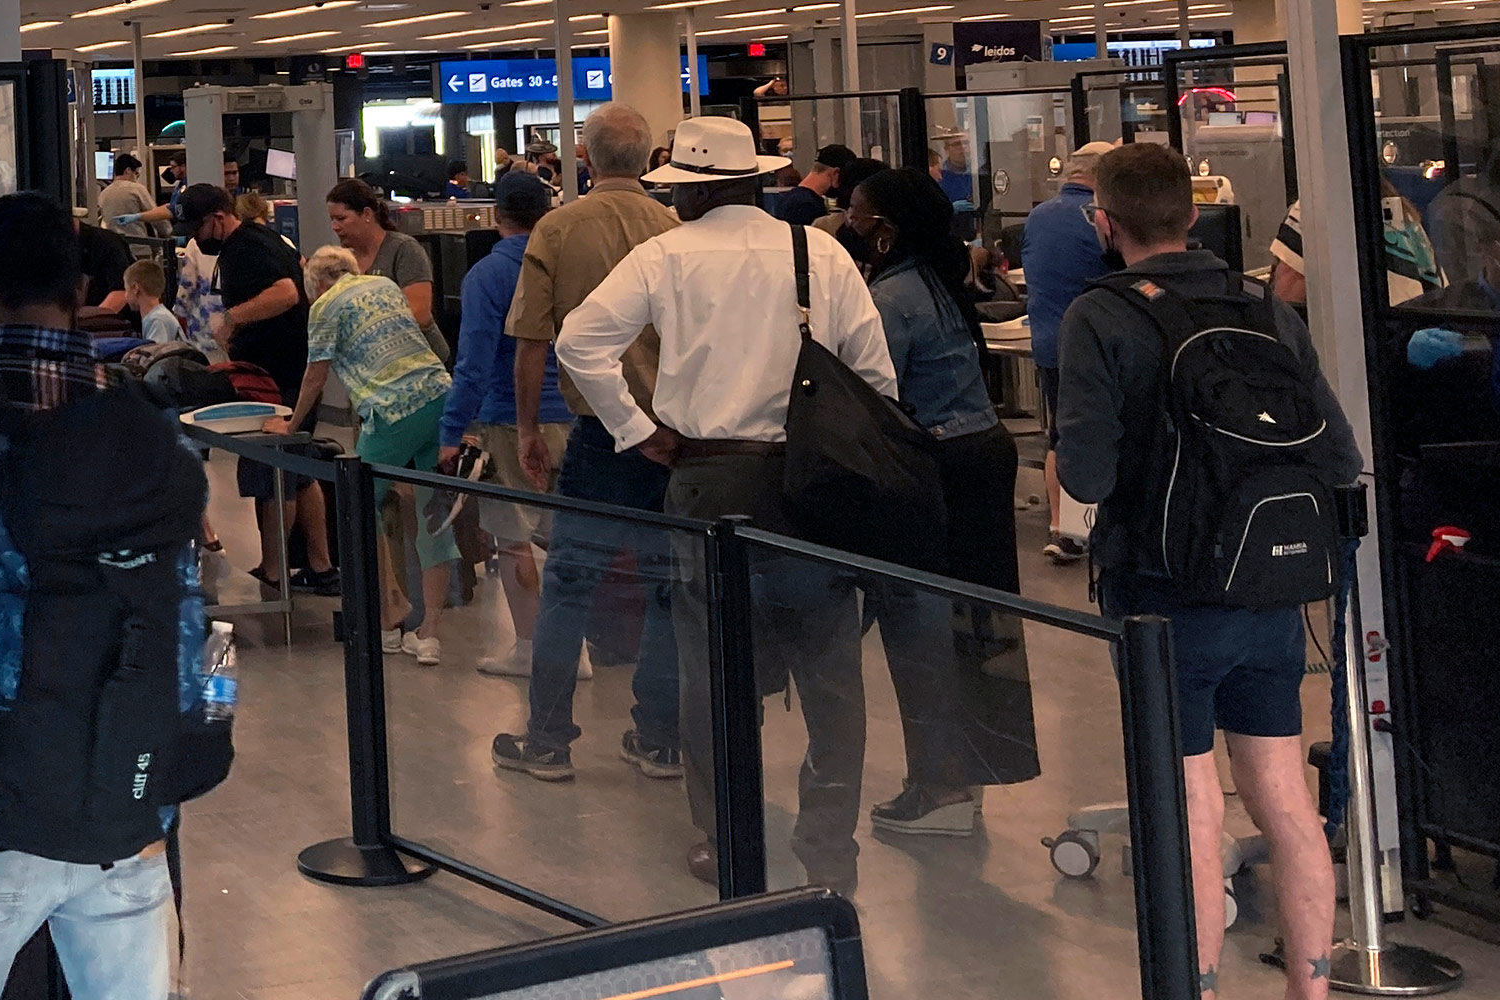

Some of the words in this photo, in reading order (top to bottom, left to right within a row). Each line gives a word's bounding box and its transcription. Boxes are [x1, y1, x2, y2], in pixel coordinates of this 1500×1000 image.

[936, 48, 947, 60] 9
[984, 46, 1015, 57] leidos
[491, 76, 523, 88] Gates
[528, 75, 543, 87] 30
[137, 753, 151, 771] 45
[132, 773, 148, 799] cliff
